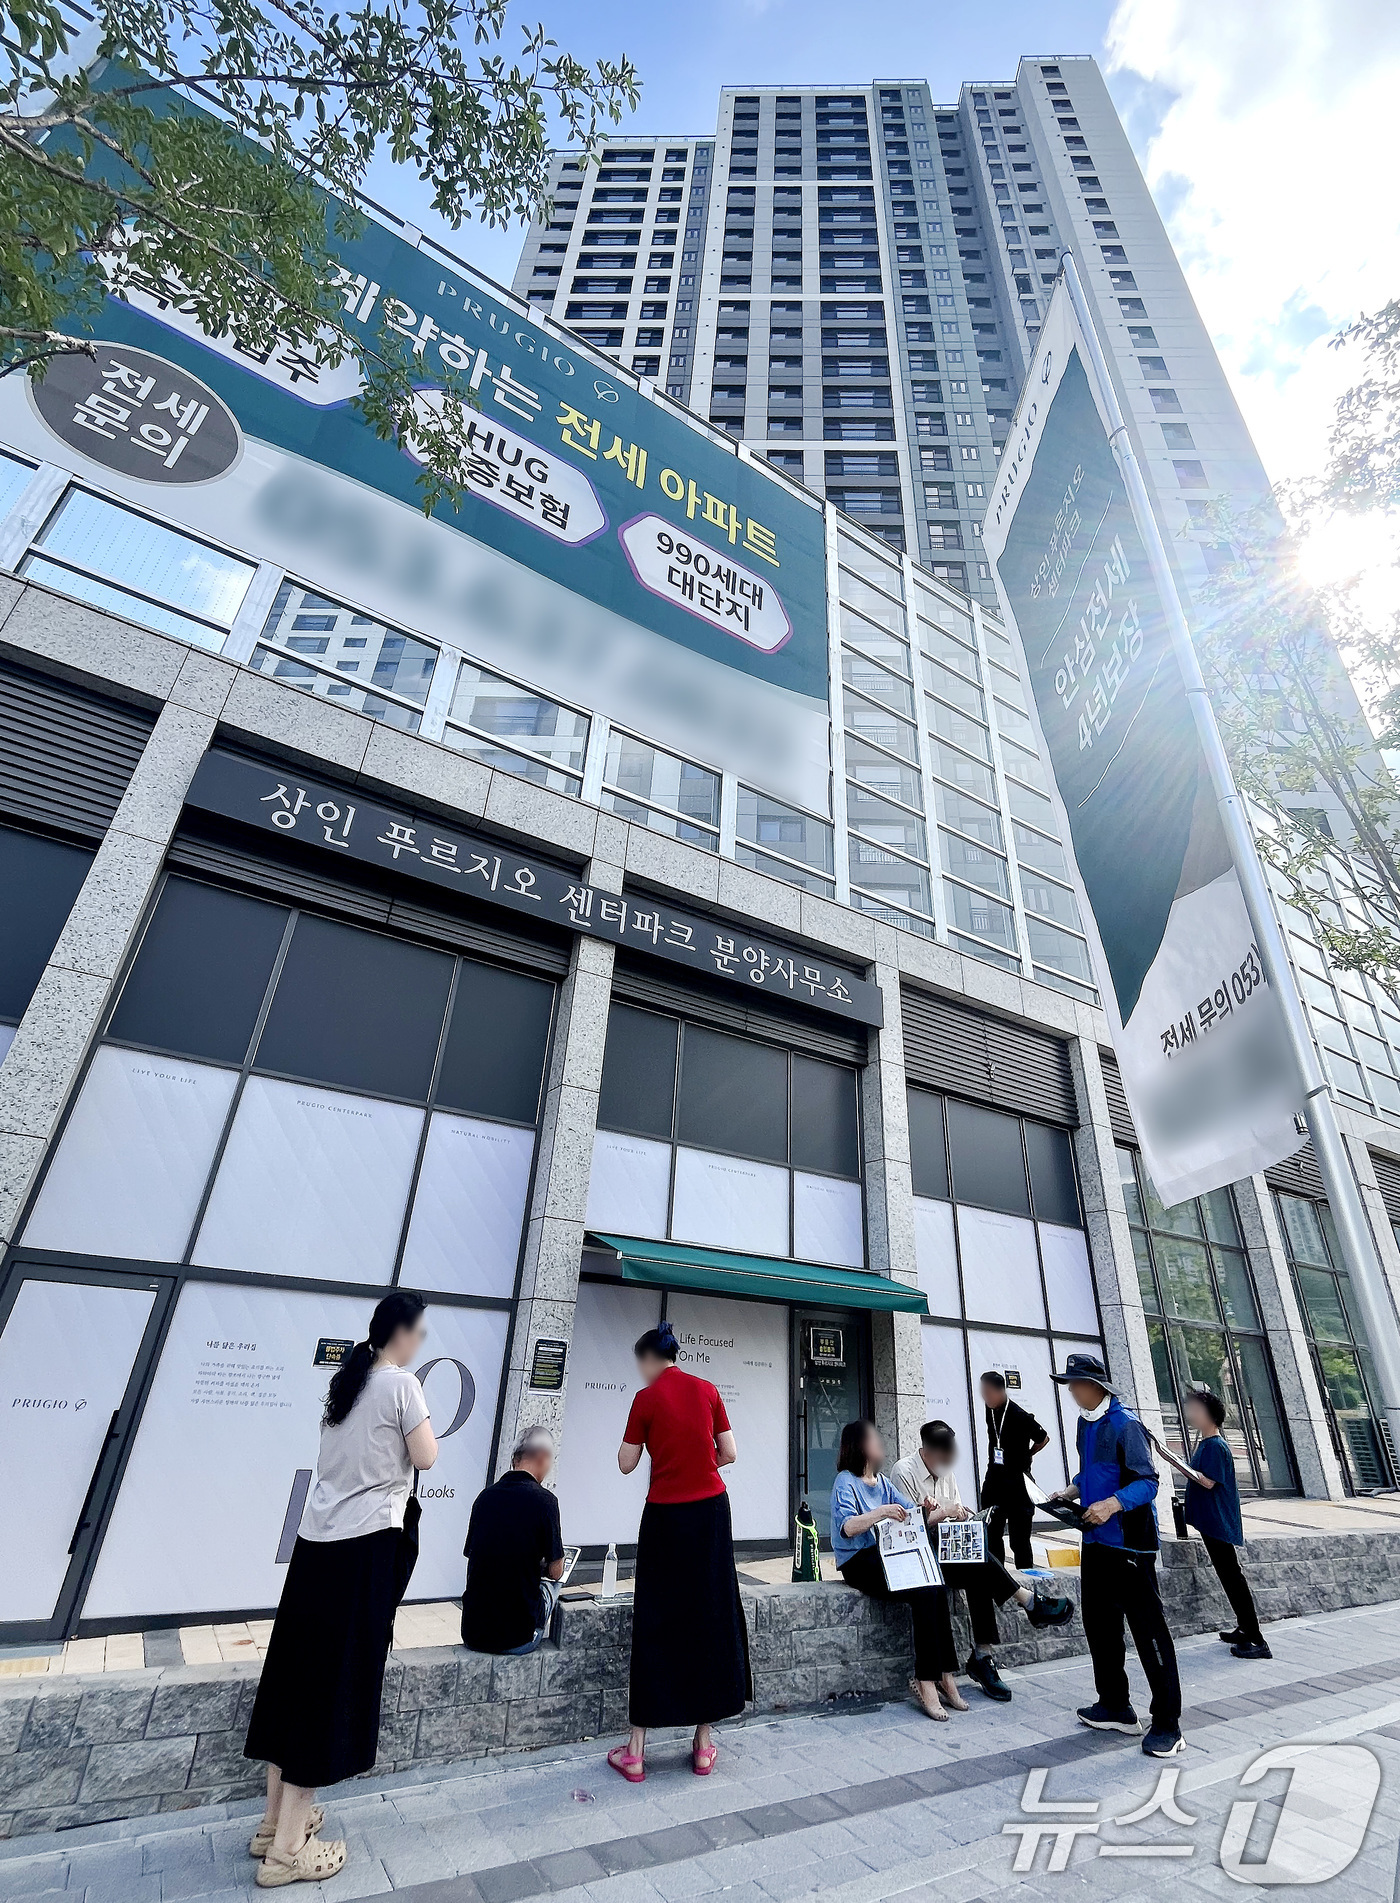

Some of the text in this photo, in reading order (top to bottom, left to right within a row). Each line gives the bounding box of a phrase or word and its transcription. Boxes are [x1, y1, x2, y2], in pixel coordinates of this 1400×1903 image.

[437, 280, 575, 377] PRUGIO
[71, 393, 191, 469] 문의
[101, 359, 211, 436] 전세
[452, 444, 571, 531] 증보험
[467, 421, 550, 485] HUG
[554, 401, 648, 490] 전세
[659, 467, 781, 568] 아파트
[656, 531, 764, 611] 990세대
[666, 563, 752, 633] 대단지
[1054, 533, 1131, 711] 안심전세
[1078, 599, 1144, 752] 4년보장
[259, 783, 853, 1004] 상인 푸르지오 센터파크 분양사무소
[1160, 1011, 1198, 1059] 전세
[1197, 979, 1234, 1034] 문의
[132, 1068, 197, 1085] LIVE YOUR LIFE
[328, 1105, 373, 1119] CENTERPARK
[451, 1129, 479, 1139] NATURAL
[678, 1350, 710, 1364] On Me
[680, 1333, 734, 1348] Life Focused
[12, 1399, 68, 1409] PRUGIO
[585, 1381, 617, 1391] PRUGIO
[420, 1484, 455, 1499] Looks
